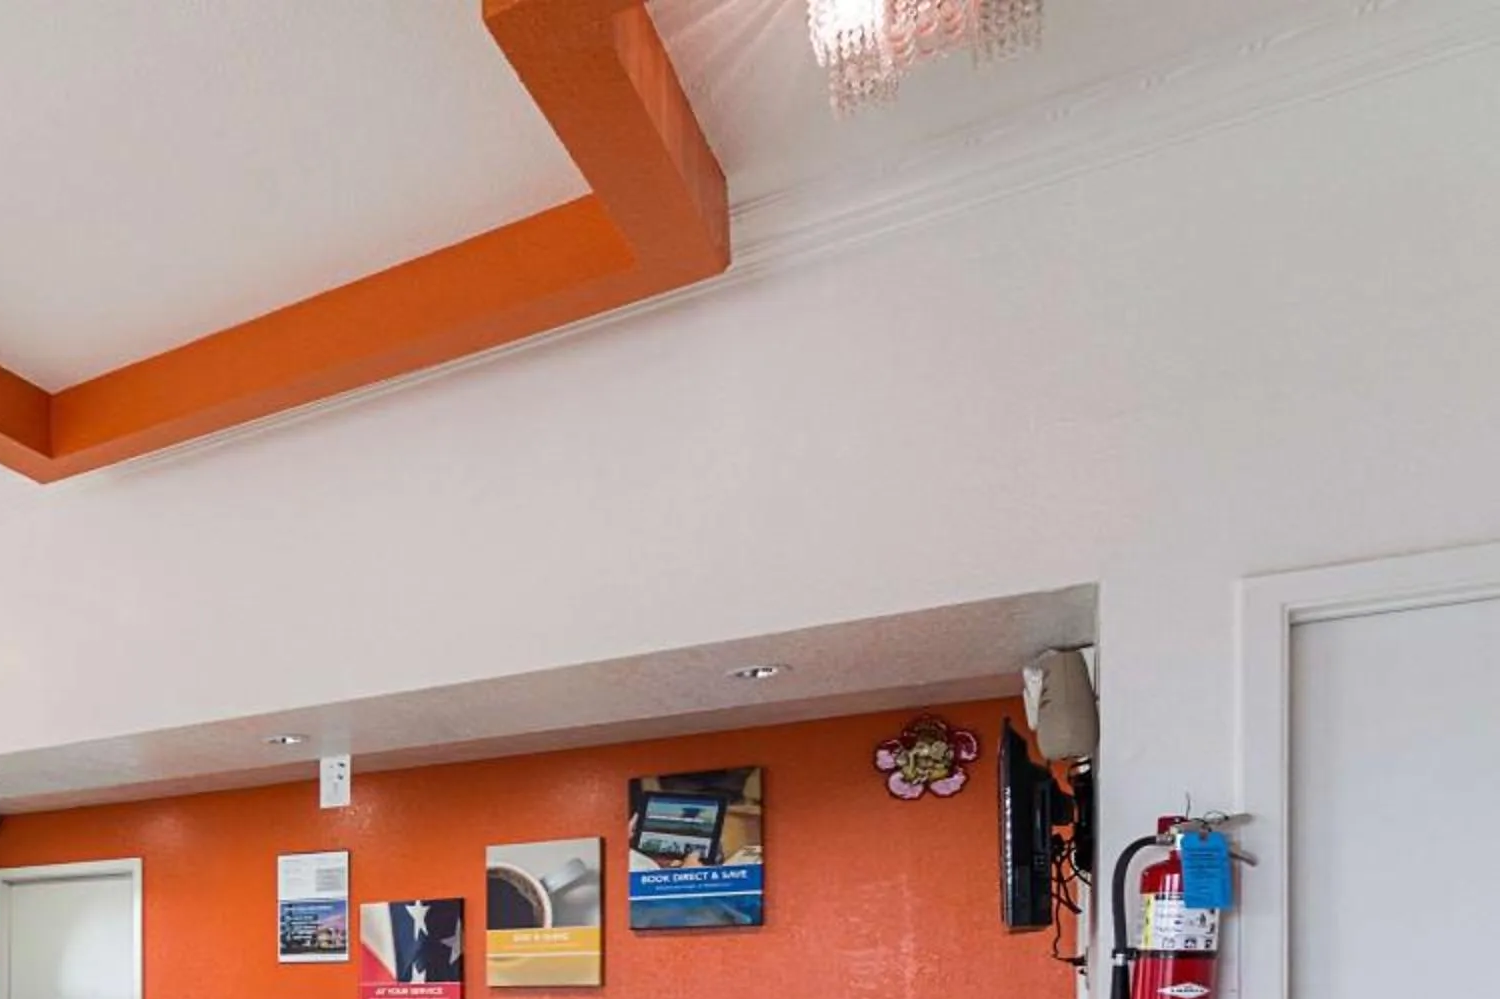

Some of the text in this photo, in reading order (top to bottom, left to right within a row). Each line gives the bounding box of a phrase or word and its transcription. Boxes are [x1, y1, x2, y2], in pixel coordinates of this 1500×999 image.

[641, 875, 670, 885] BOOK
[673, 871, 708, 882] DIRECT
[721, 869, 748, 880] SAVE
